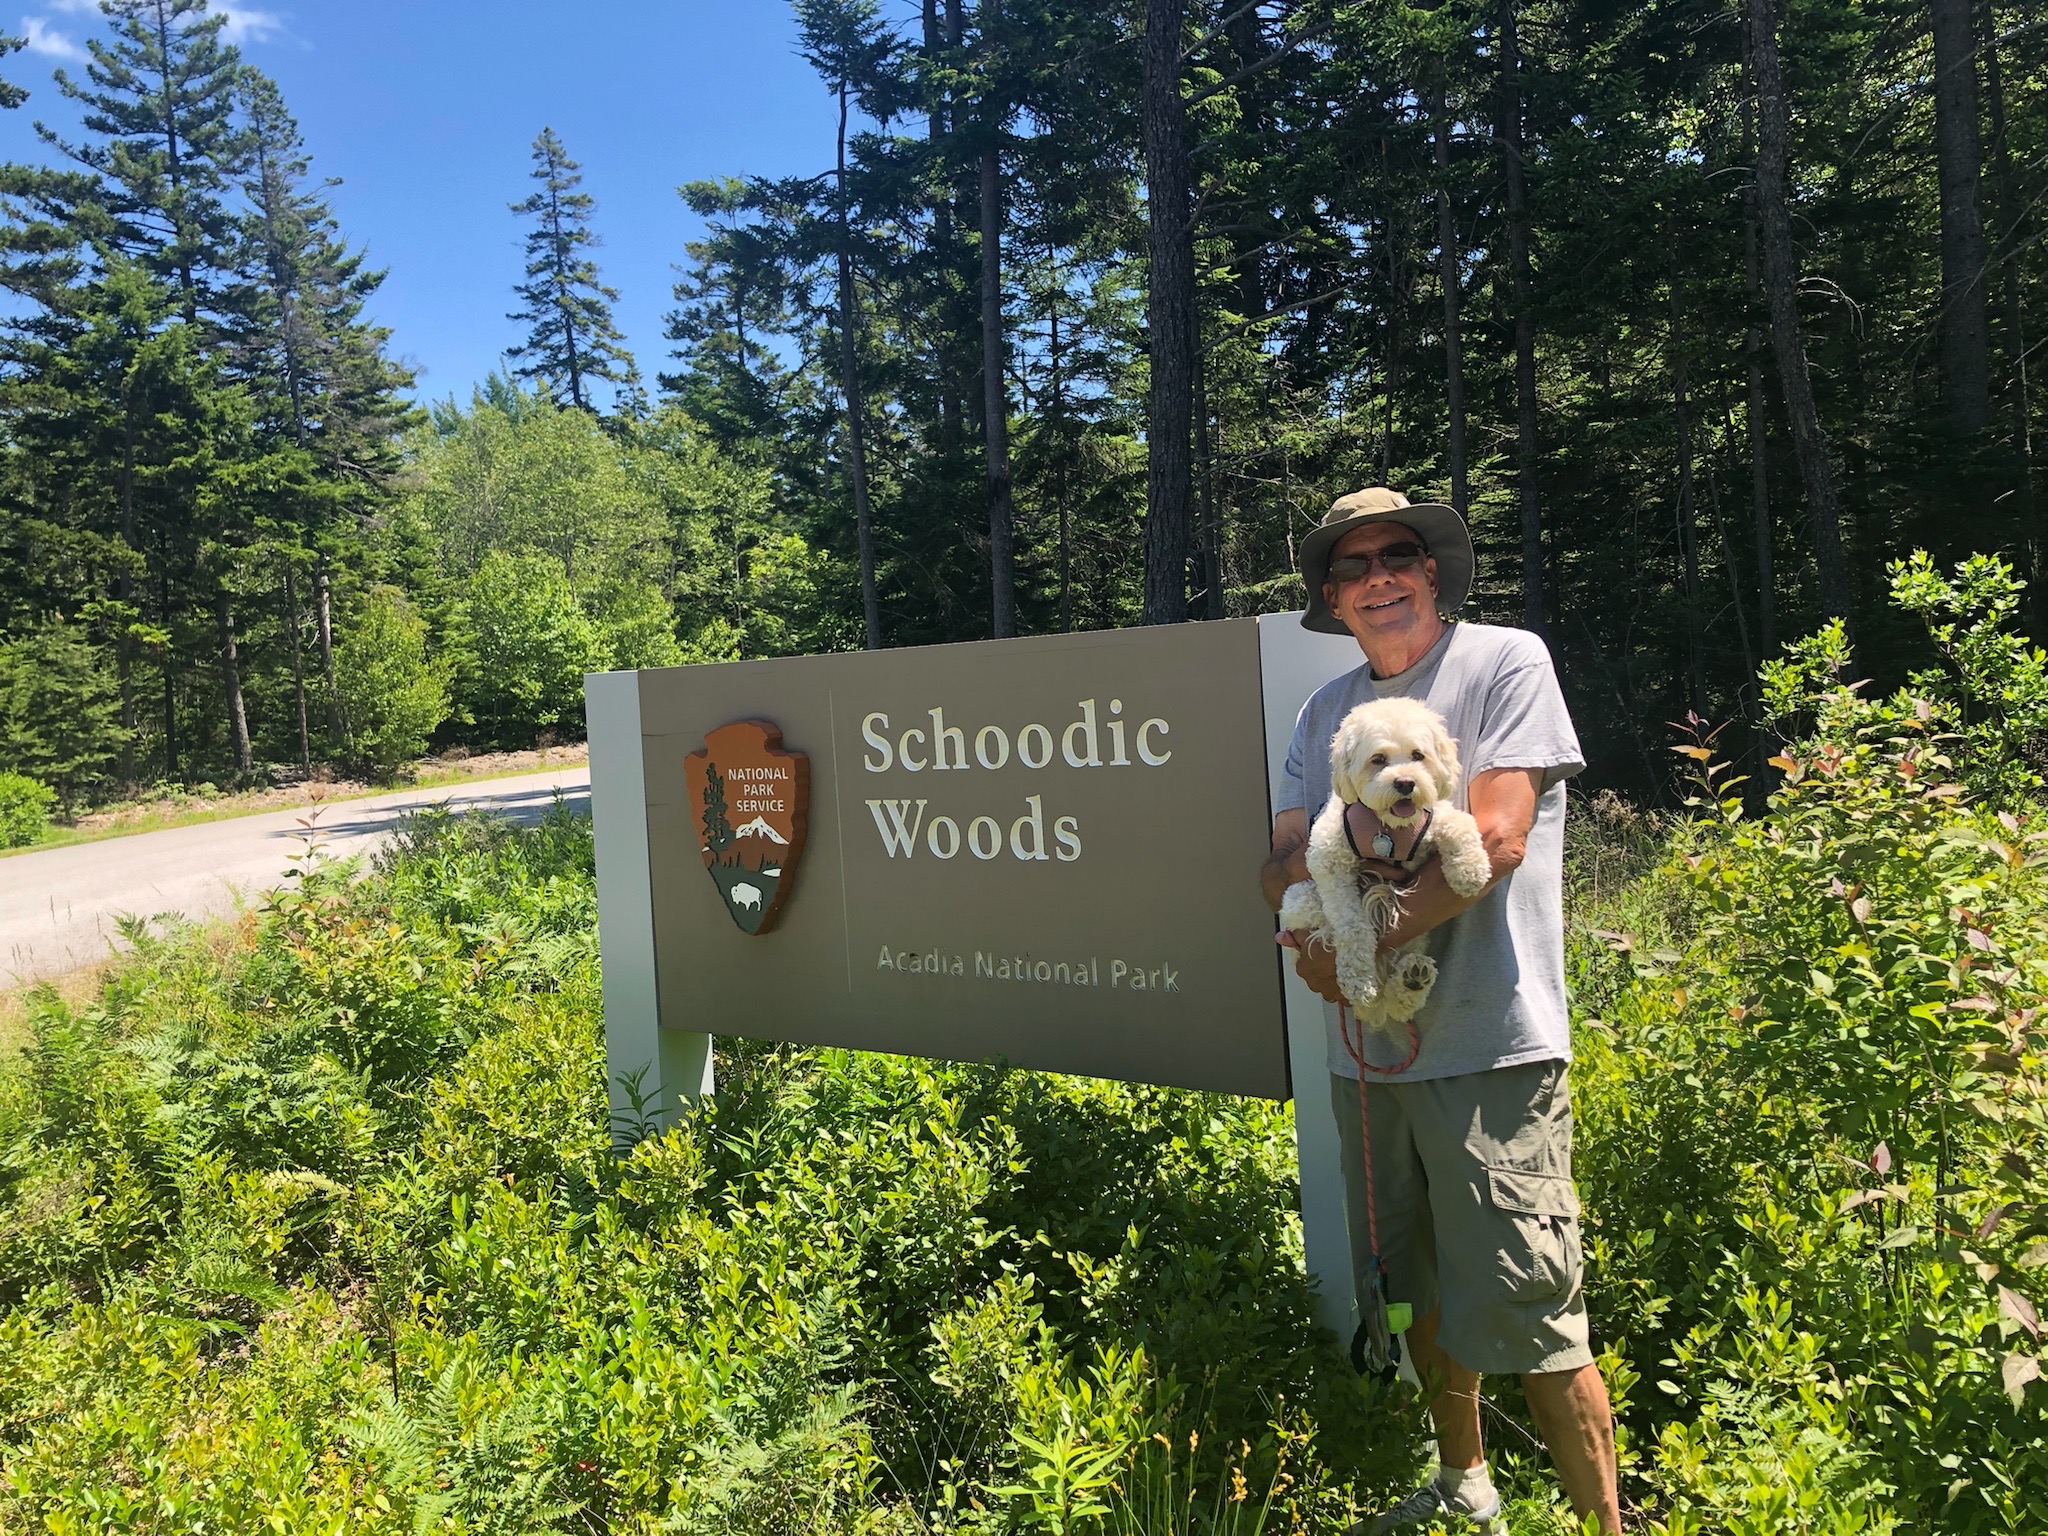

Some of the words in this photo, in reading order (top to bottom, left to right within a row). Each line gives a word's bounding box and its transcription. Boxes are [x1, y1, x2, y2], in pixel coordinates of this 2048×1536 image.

[861, 698, 1172, 773] Schoodic
[728, 767, 789, 781] NATIONAL
[736, 799, 785, 812] SERVICE
[743, 784, 775, 796] PARK
[865, 794, 1082, 862] Woods
[877, 944, 964, 976] Acadia
[975, 950, 1098, 987] National
[1110, 959, 1180, 993] Park
